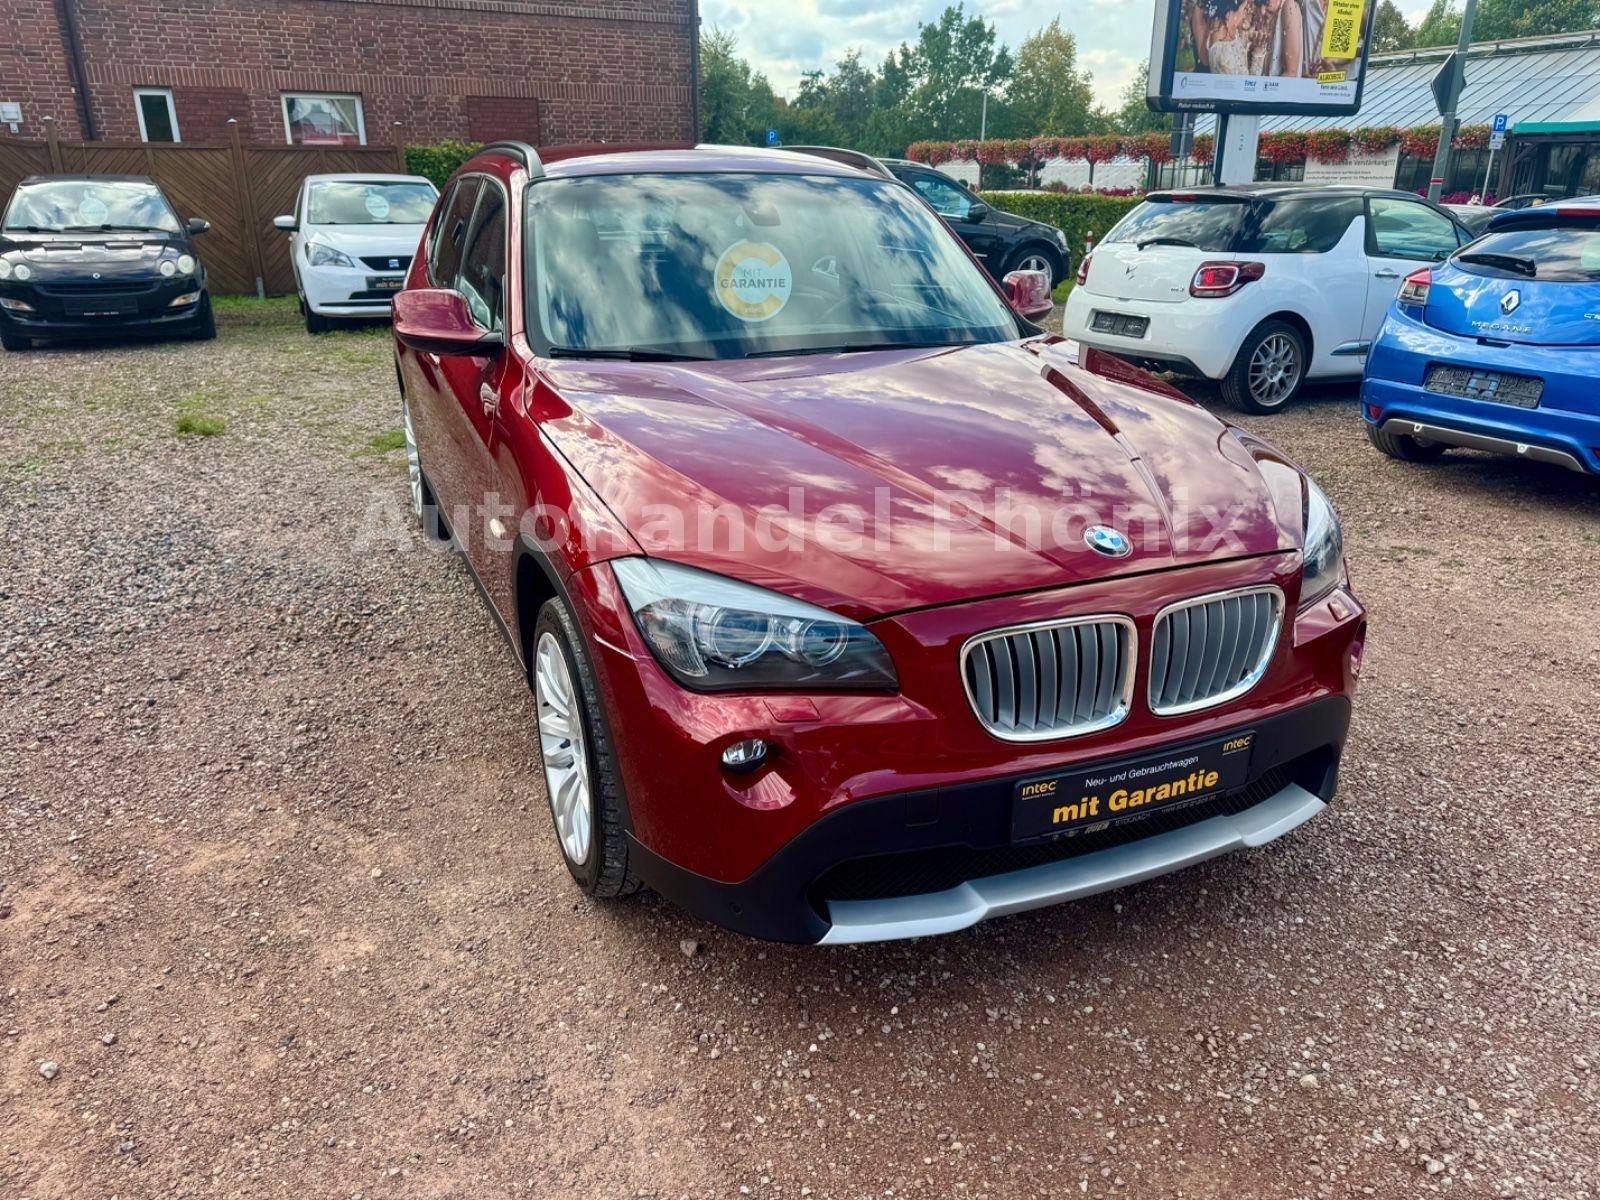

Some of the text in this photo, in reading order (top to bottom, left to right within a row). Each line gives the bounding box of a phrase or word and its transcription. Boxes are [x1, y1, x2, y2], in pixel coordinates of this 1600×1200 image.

[720, 278, 786, 289] GARANTIE
[743, 268, 761, 278] MIT
[1084, 755, 1200, 789] Neu- und Gebrauchtwagen
[1052, 768, 1220, 824] mit Garantie
